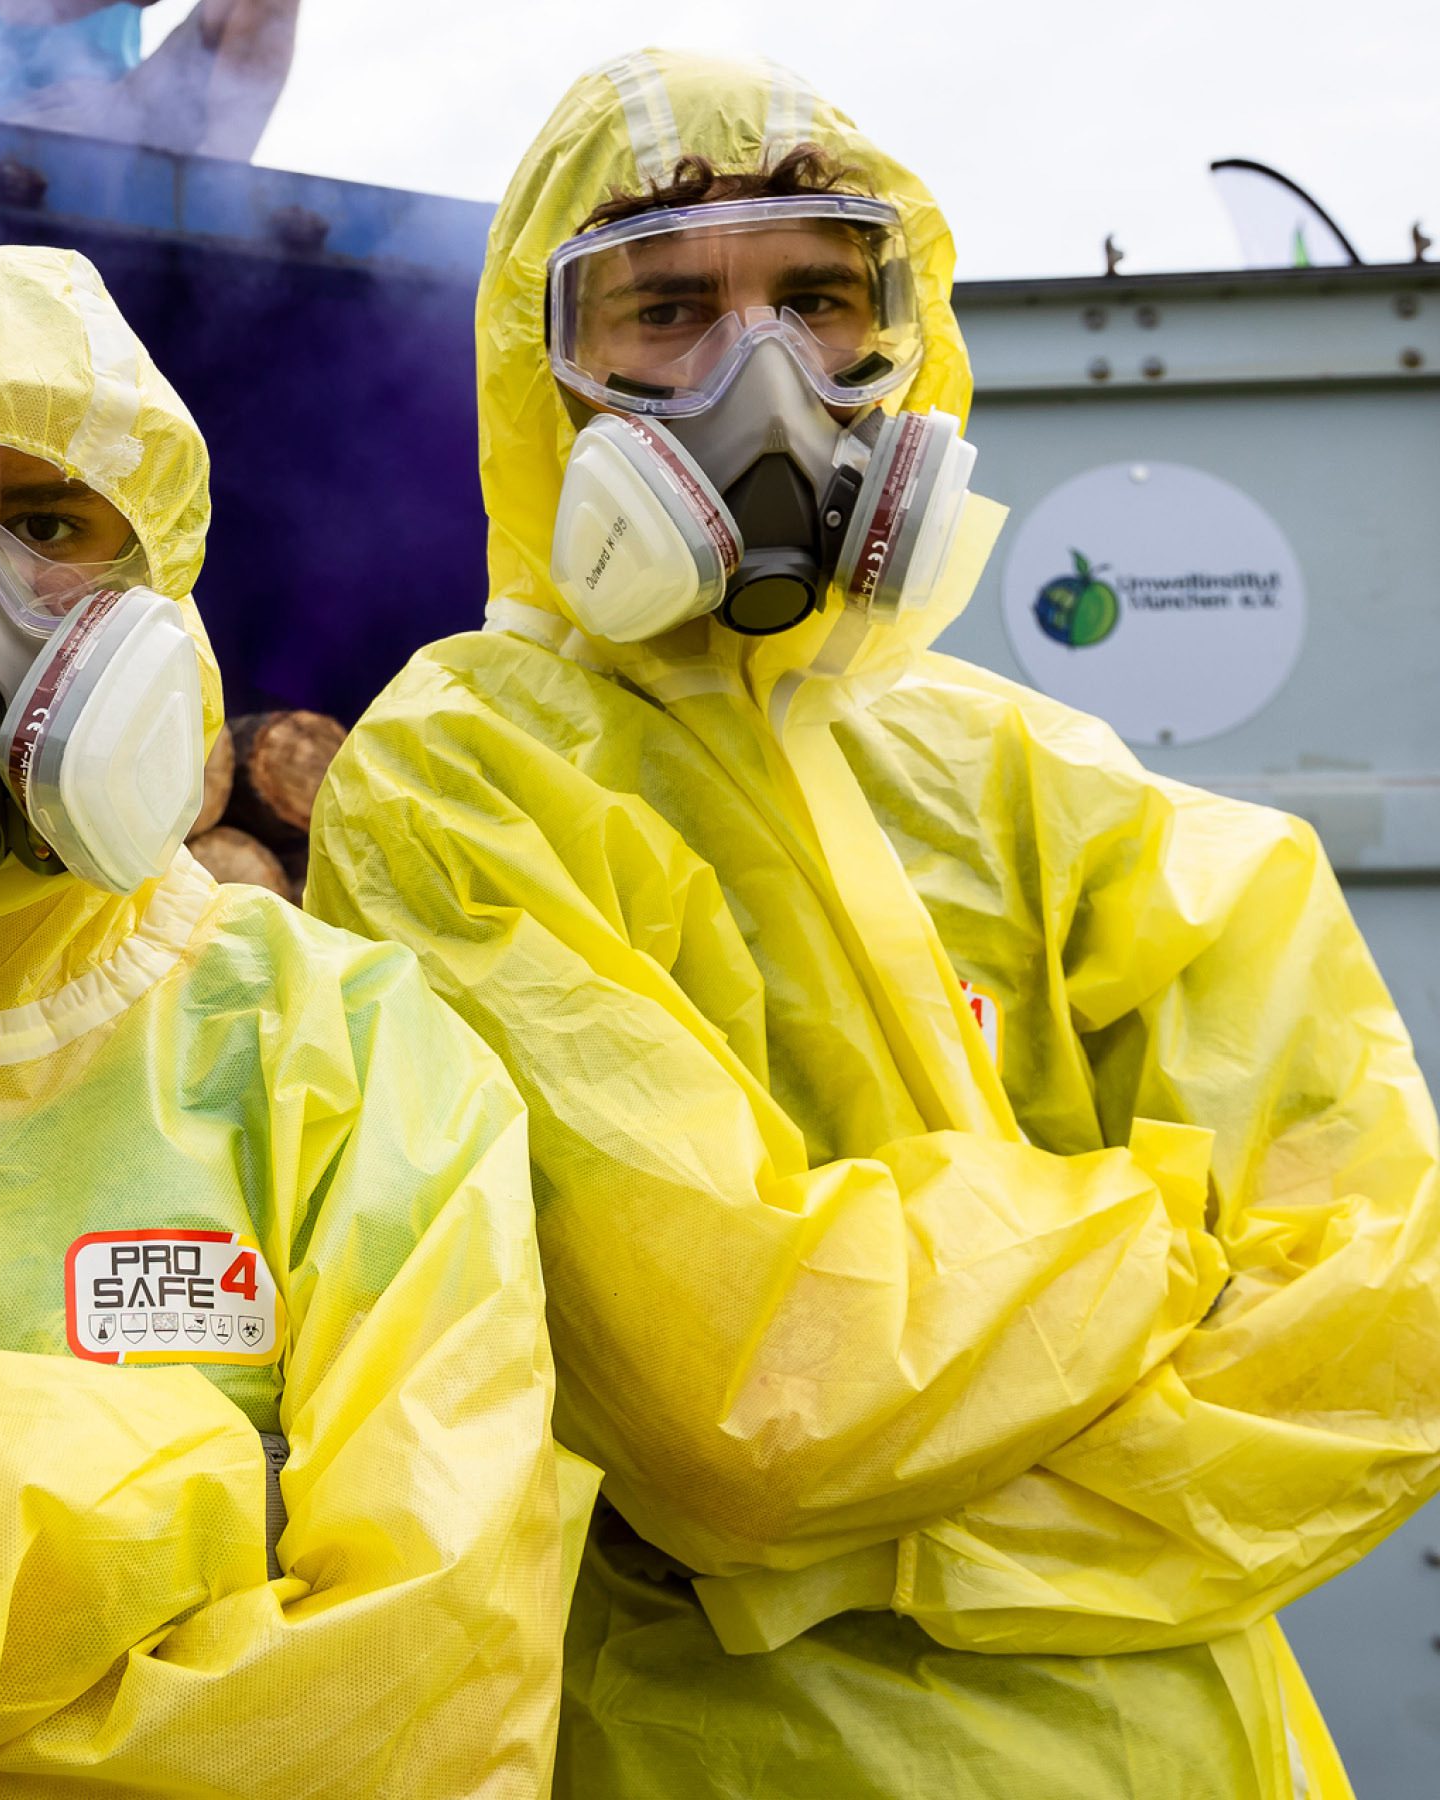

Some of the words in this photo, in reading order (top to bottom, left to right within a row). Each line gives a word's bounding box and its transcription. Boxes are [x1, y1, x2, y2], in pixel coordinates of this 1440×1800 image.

[585, 546, 610, 590] Outward
[26, 708, 50, 734] CE
[111, 1245, 201, 1275] PRO
[93, 1277, 214, 1309] SAFE
[220, 1251, 258, 1301] 4
